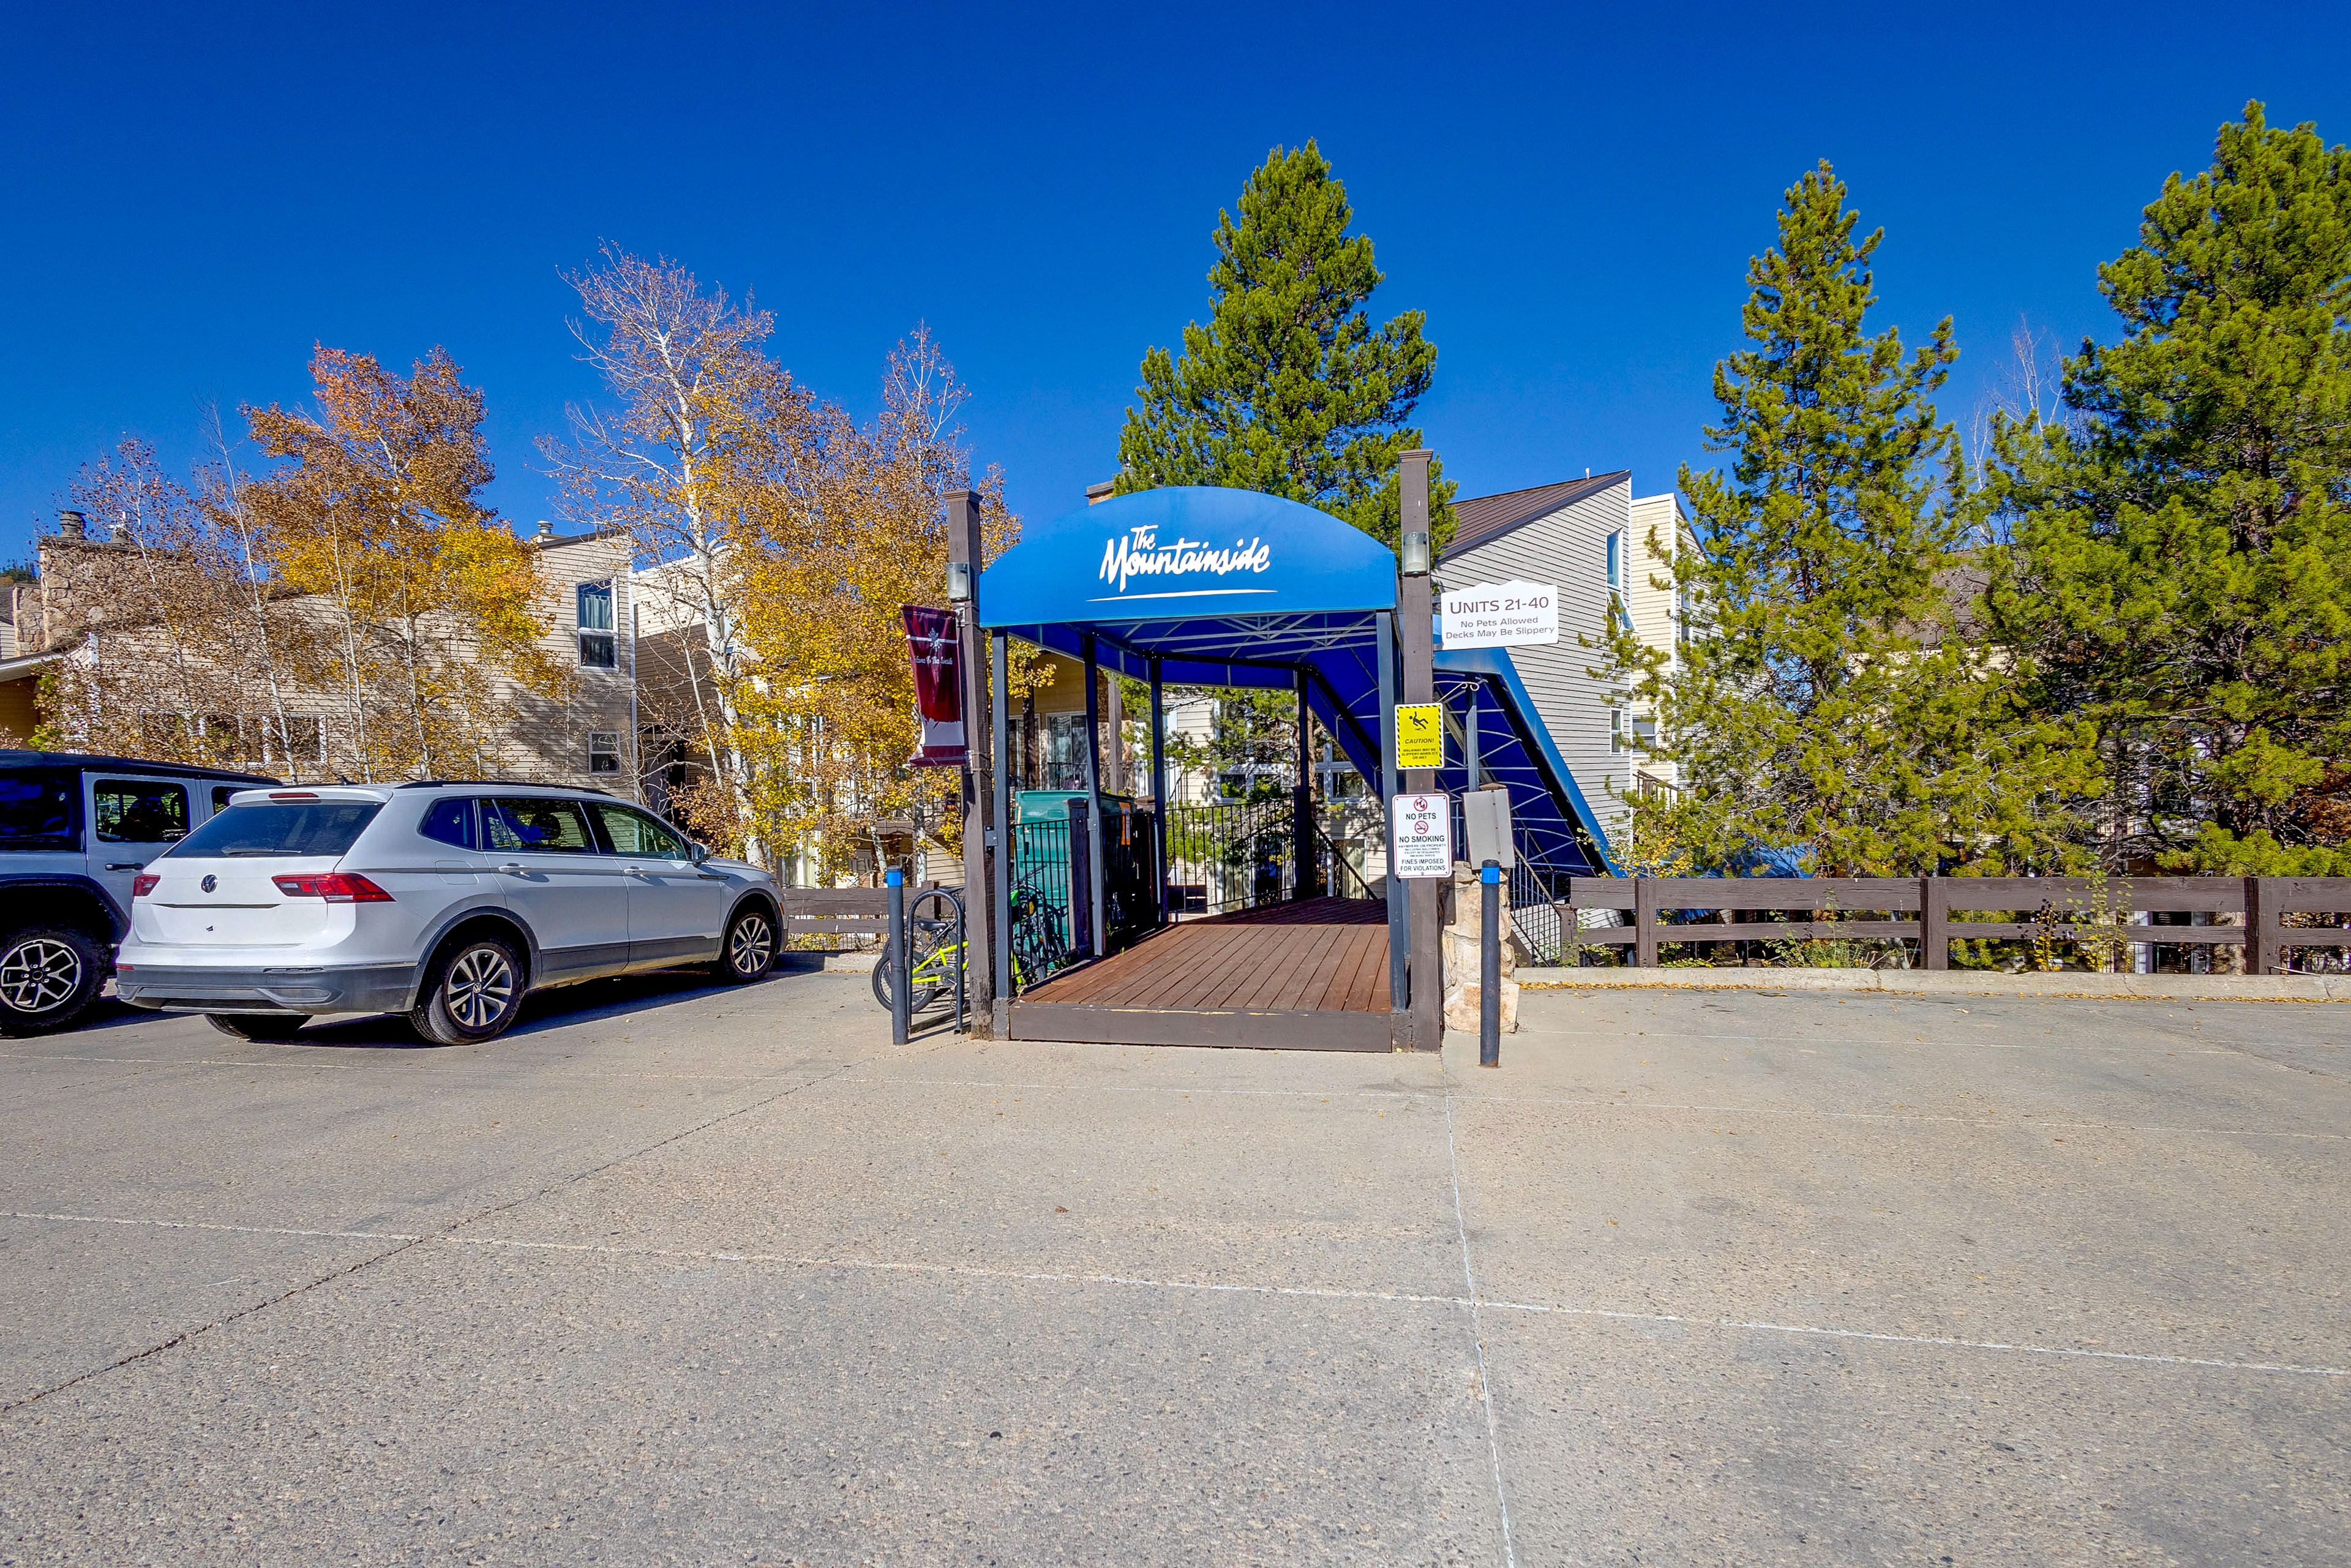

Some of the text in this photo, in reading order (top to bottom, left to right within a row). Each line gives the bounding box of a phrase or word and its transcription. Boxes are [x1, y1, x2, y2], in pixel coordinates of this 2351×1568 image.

[1130, 525, 1158, 550] The
[1099, 536, 1270, 593] Mountainside
[1450, 597, 1549, 613] UNITS 21-40
[1500, 617, 1538, 625] Allowed
